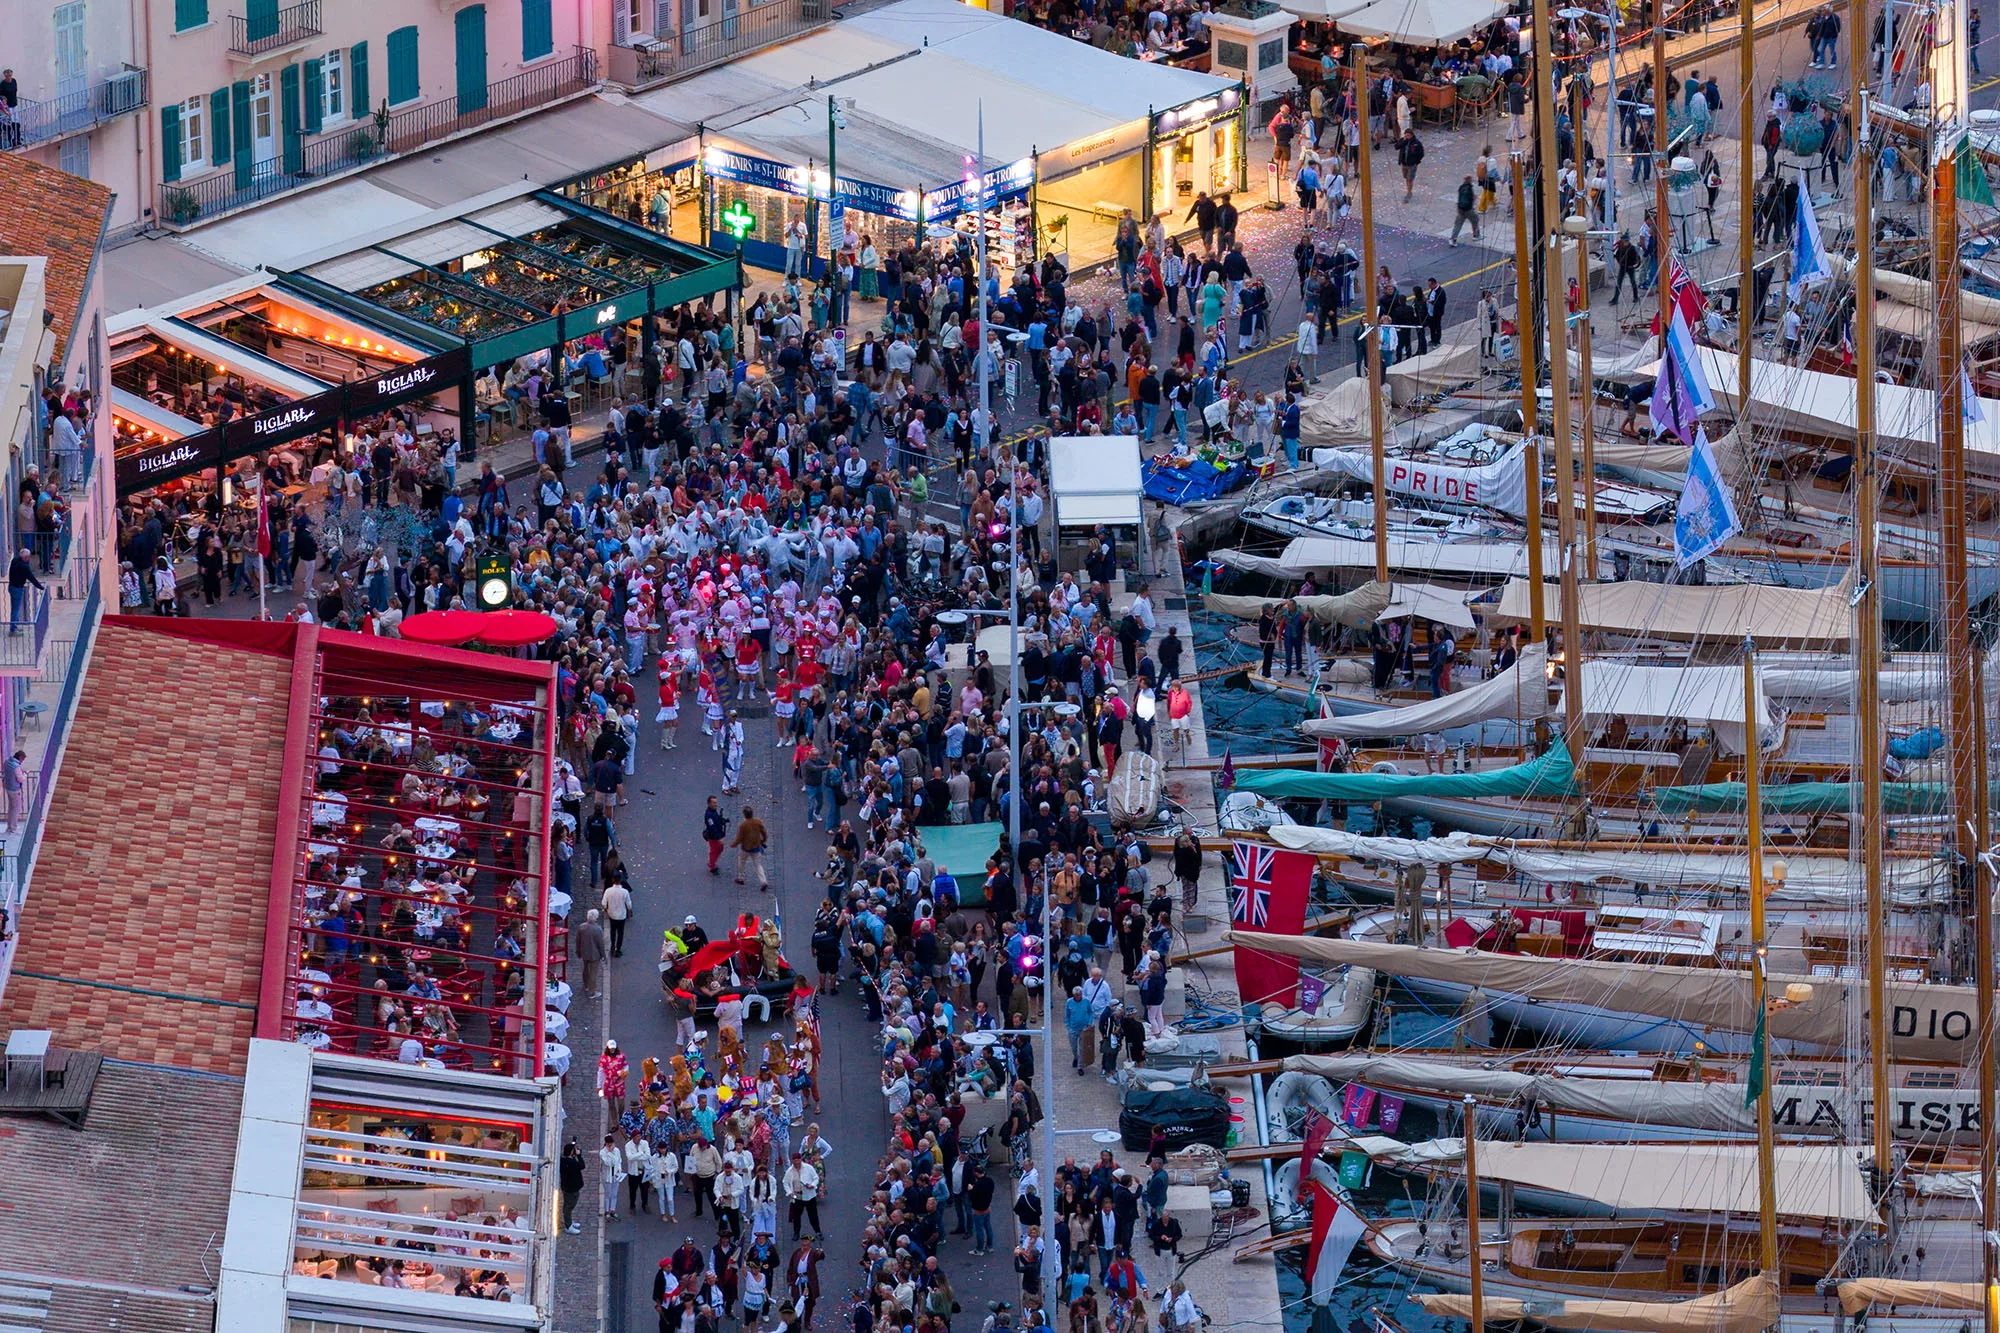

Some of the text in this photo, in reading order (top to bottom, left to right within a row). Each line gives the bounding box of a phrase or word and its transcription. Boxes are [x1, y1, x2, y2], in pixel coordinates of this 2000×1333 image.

[833, 203, 840, 215] P
[1393, 466, 1478, 501] PRIDE
[482, 567, 506, 575] ROLEX
